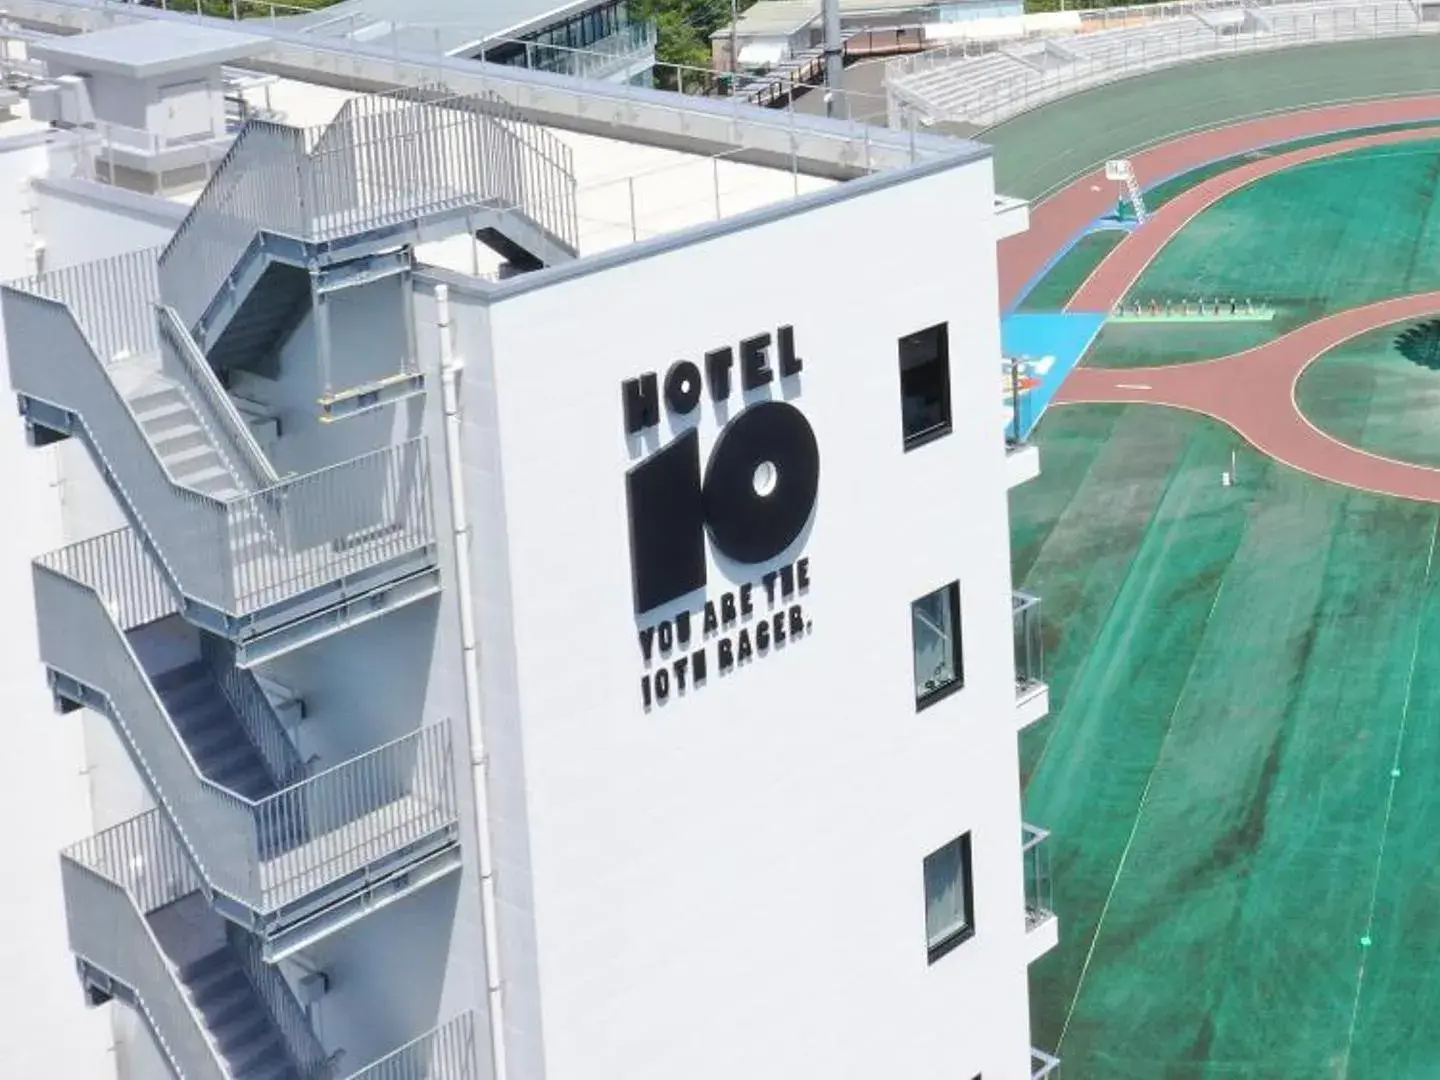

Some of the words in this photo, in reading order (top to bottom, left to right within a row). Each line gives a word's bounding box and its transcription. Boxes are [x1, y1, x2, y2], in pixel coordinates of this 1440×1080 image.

[621, 324, 803, 434] HOTEL
[625, 401, 820, 614] 10
[639, 610, 691, 662] YOU
[703, 582, 753, 635] ARE
[762, 557, 810, 604] THE
[641, 647, 707, 707] 10TH
[718, 604, 812, 671] RACER.
